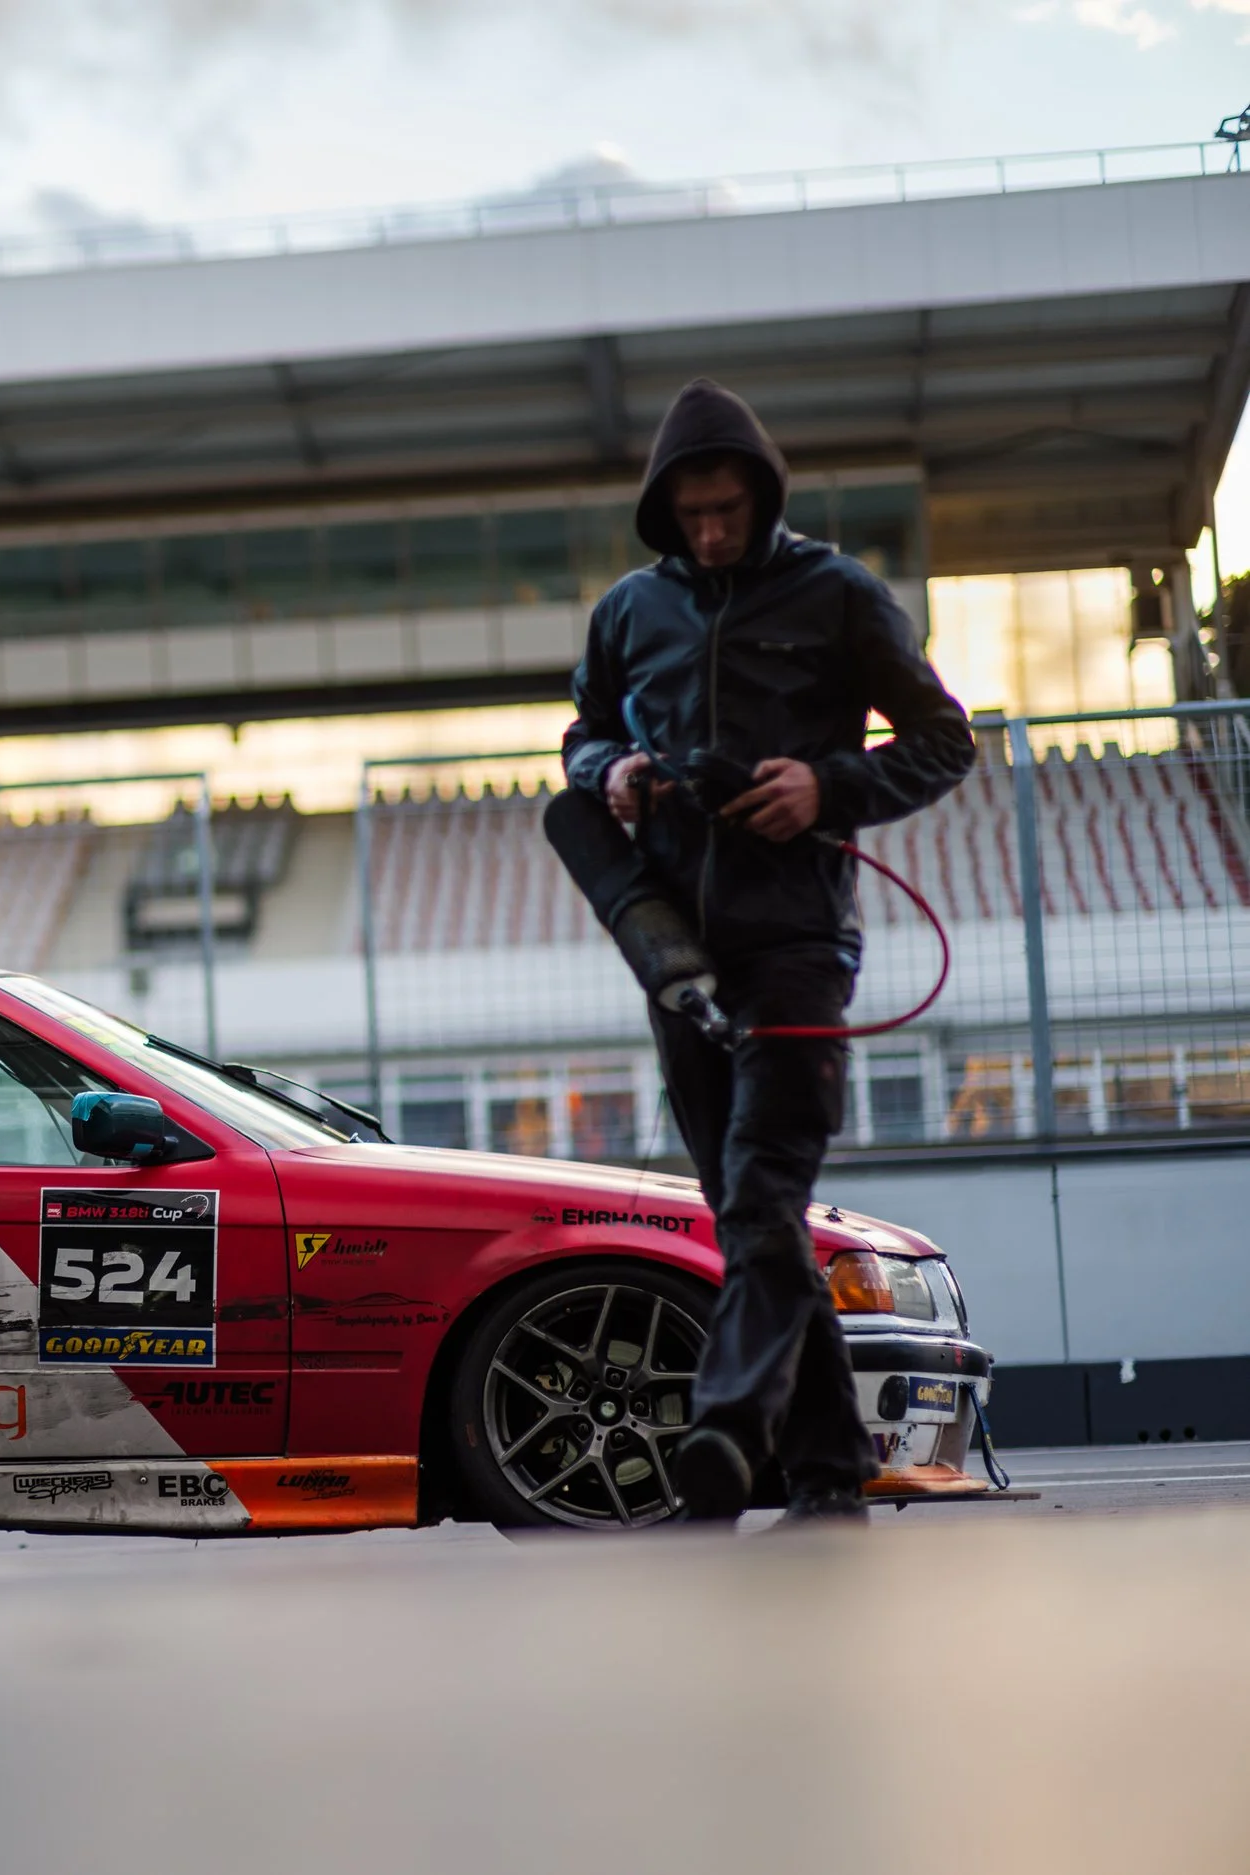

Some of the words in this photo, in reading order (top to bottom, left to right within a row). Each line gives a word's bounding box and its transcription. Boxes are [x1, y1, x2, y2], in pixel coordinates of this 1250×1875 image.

[66, 1206, 107, 1218] BMW
[109, 1206, 149, 1219] 318ti
[152, 1207, 183, 1221] Cup
[562, 1208, 696, 1234] EHRHARDT
[50, 1248, 196, 1304] 524
[45, 1335, 207, 1356] GOODYEAR
[161, 1381, 275, 1405] AUTEC
[158, 1473, 228, 1498] EBC
[180, 1498, 226, 1506] BRAKES
